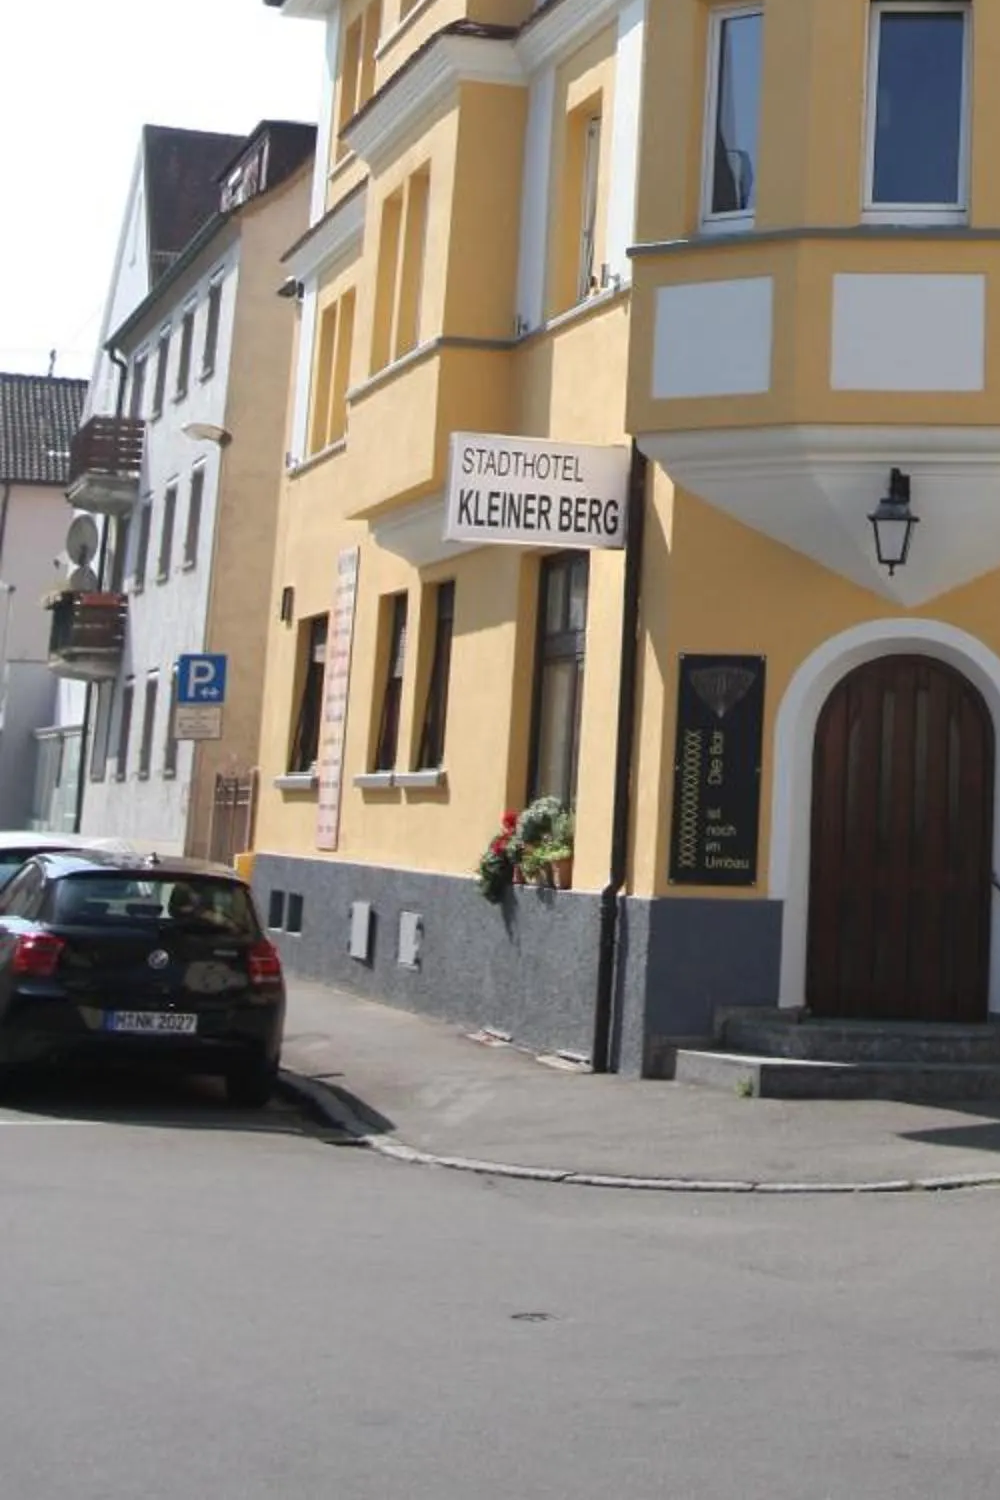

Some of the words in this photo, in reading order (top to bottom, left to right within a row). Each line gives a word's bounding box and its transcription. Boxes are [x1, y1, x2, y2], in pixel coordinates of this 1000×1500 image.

[462, 447, 584, 483] STADTHOTEL
[457, 489, 552, 531] KLEINER
[557, 496, 619, 535] BERG
[187, 660, 216, 699] P
[709, 730, 724, 755] Bar
[706, 824, 737, 837] noch
[704, 855, 750, 870] Umbau
